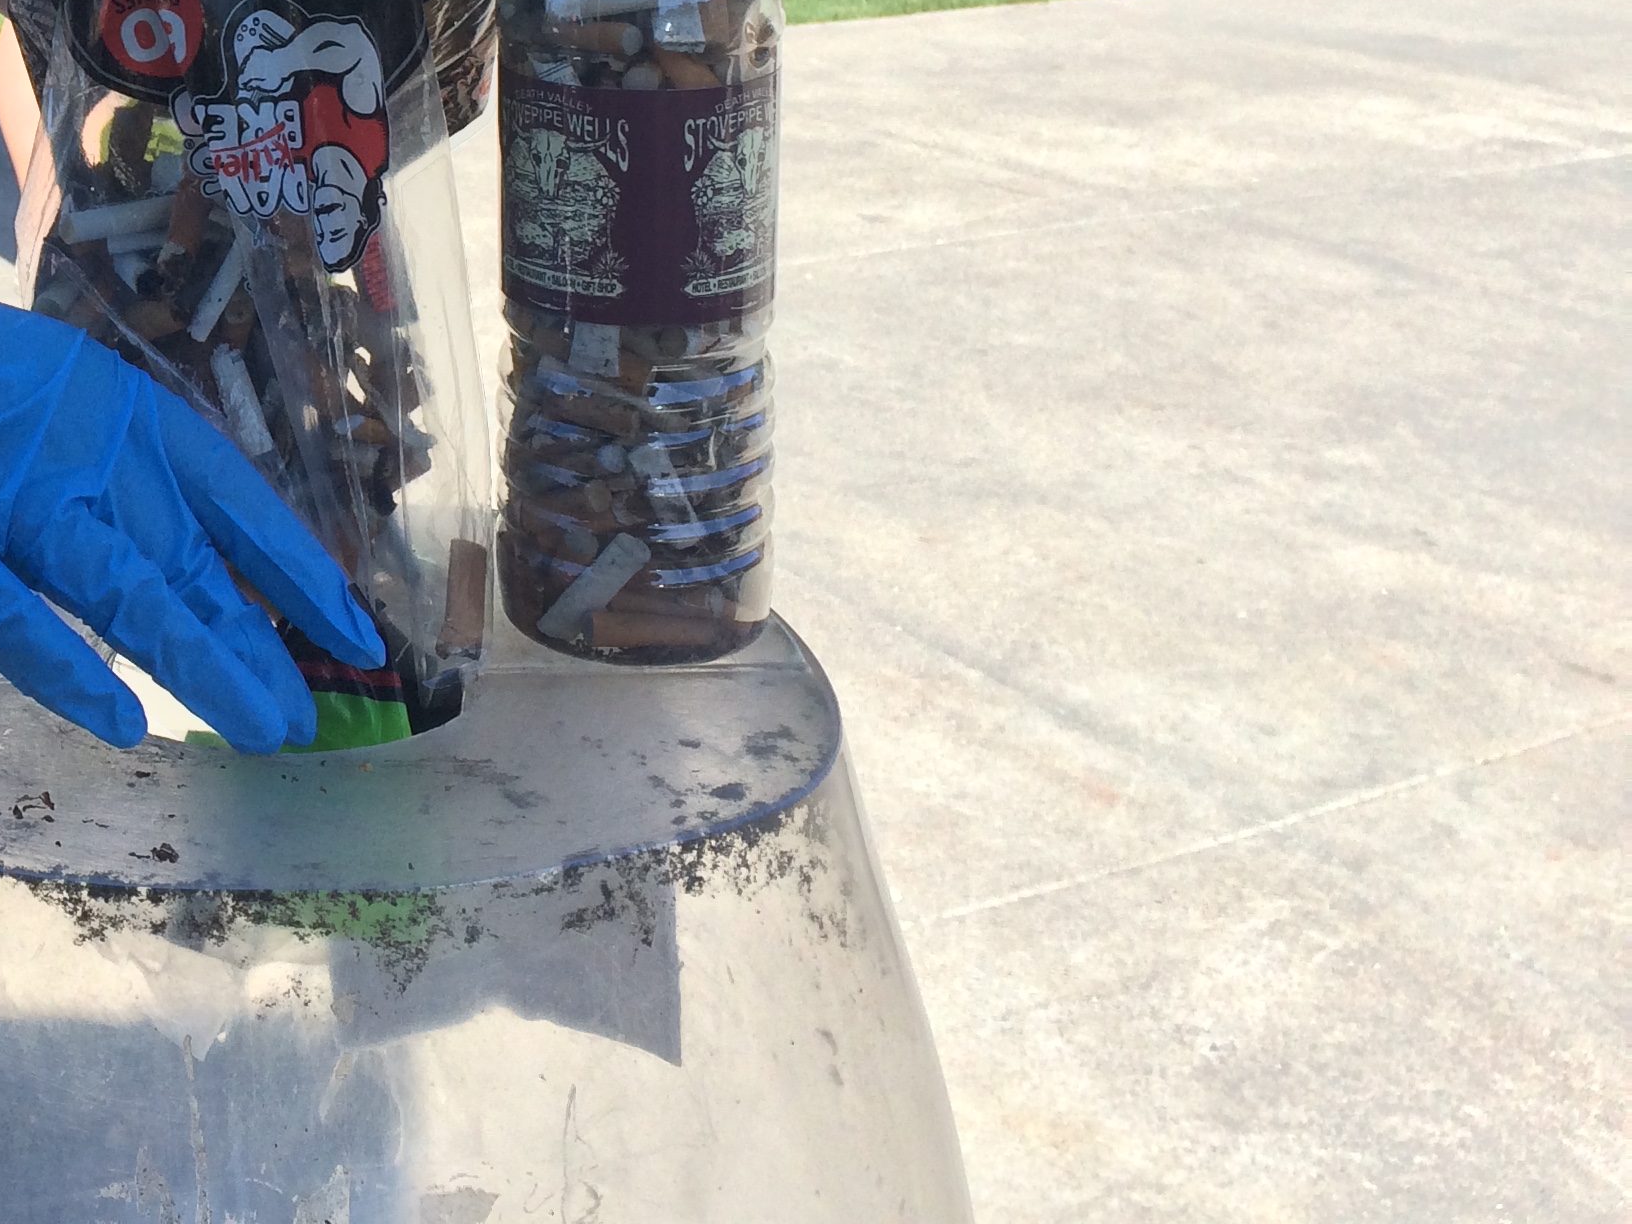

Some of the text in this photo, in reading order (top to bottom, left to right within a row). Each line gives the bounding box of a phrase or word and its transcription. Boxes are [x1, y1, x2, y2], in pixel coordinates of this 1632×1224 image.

[120, 8, 187, 64] 60
[169, 89, 303, 149] BRED
[546, 91, 593, 114] VALLEY
[714, 90, 750, 114] DEATH
[566, 112, 630, 172] WELLS
[684, 105, 763, 172] STOVEPIPE
[581, 280, 596, 295] GIFT
[597, 281, 617, 294] SHOP
[692, 281, 712, 293] HOTEL
